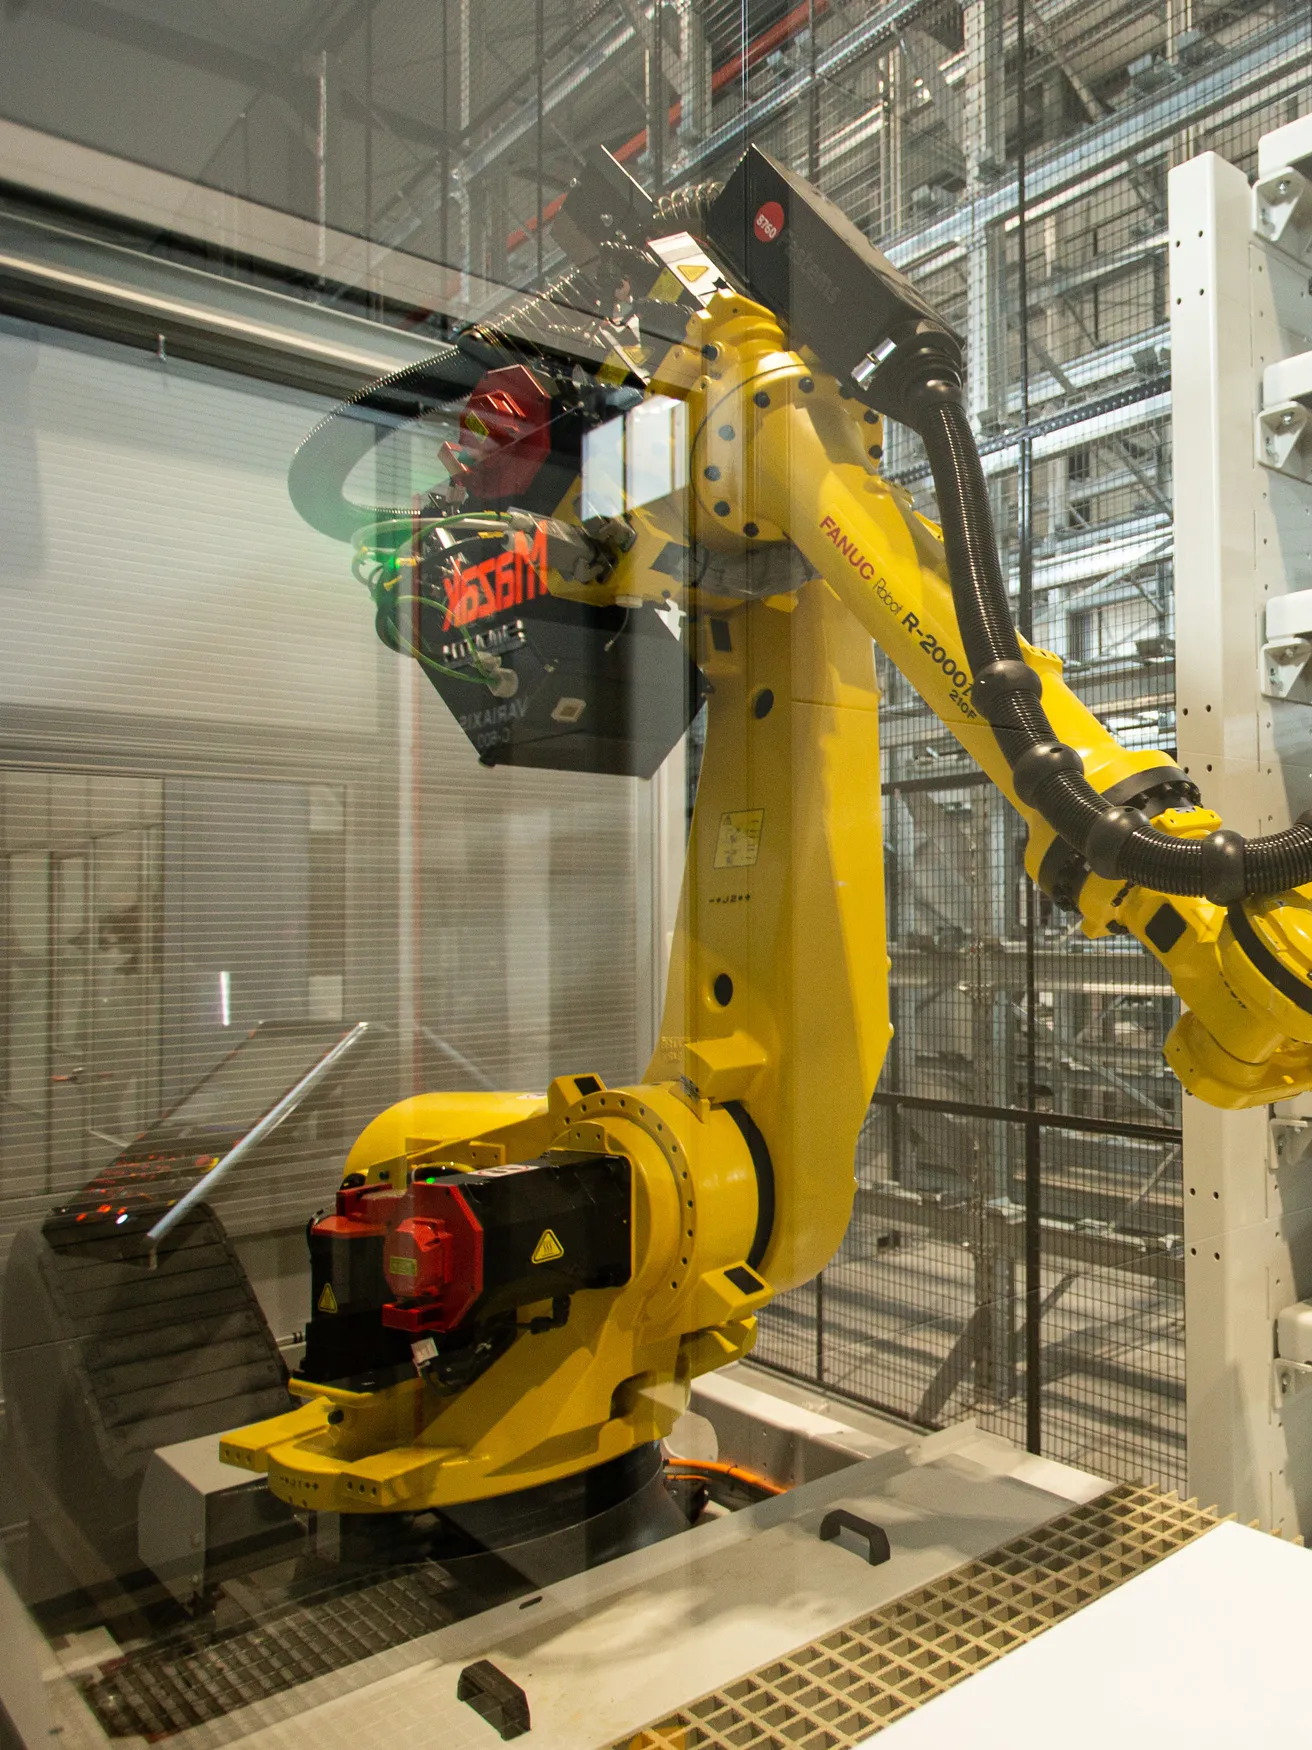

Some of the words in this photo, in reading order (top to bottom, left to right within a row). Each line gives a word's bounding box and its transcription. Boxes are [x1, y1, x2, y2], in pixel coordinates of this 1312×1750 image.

[756, 214, 777, 240] 8760
[819, 515, 875, 581] FANUC
[873, 578, 904, 616] Robot
[948, 688, 977, 719] 210F
